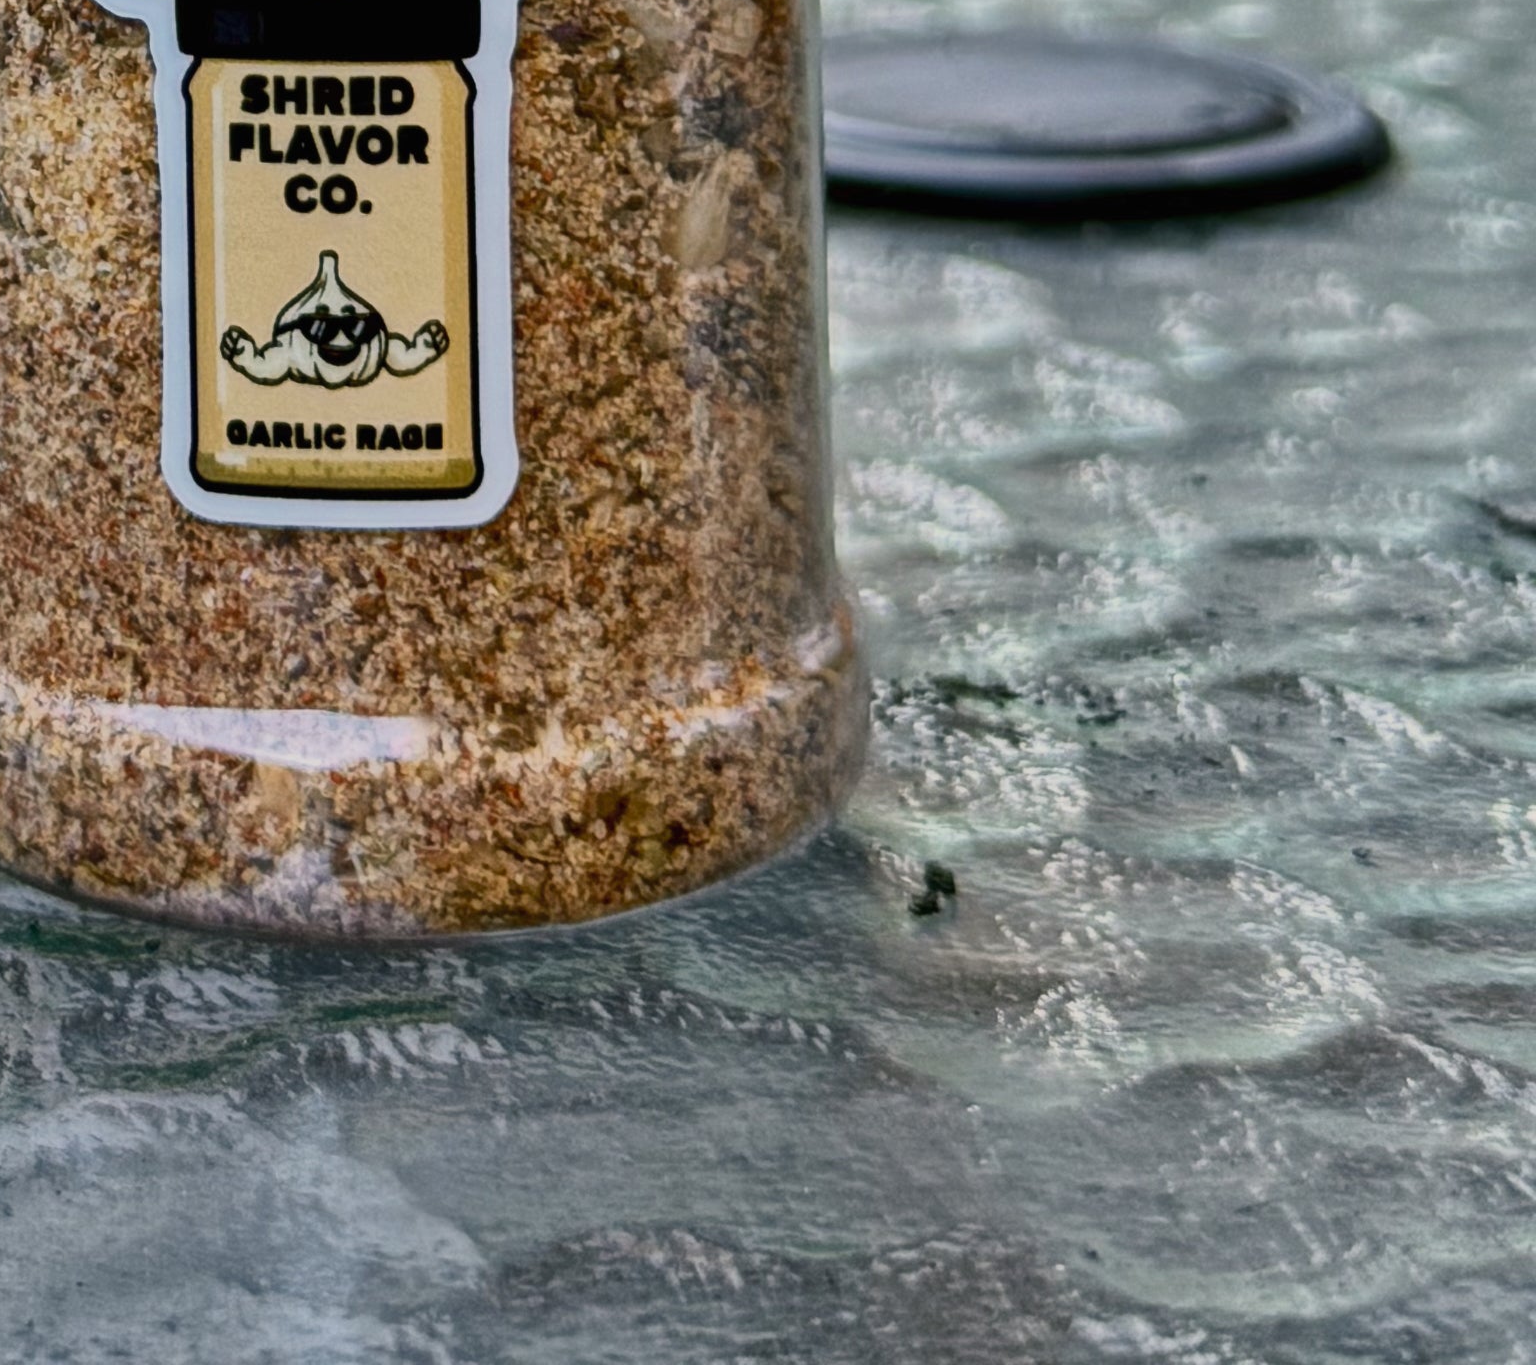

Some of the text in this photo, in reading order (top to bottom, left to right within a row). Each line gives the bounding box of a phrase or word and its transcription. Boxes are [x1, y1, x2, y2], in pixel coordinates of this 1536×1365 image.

[241, 74, 415, 116] SHRED
[229, 123, 429, 166] FLAVOR
[284, 174, 372, 214] CO.
[227, 419, 443, 450] GARLIC RAGE
